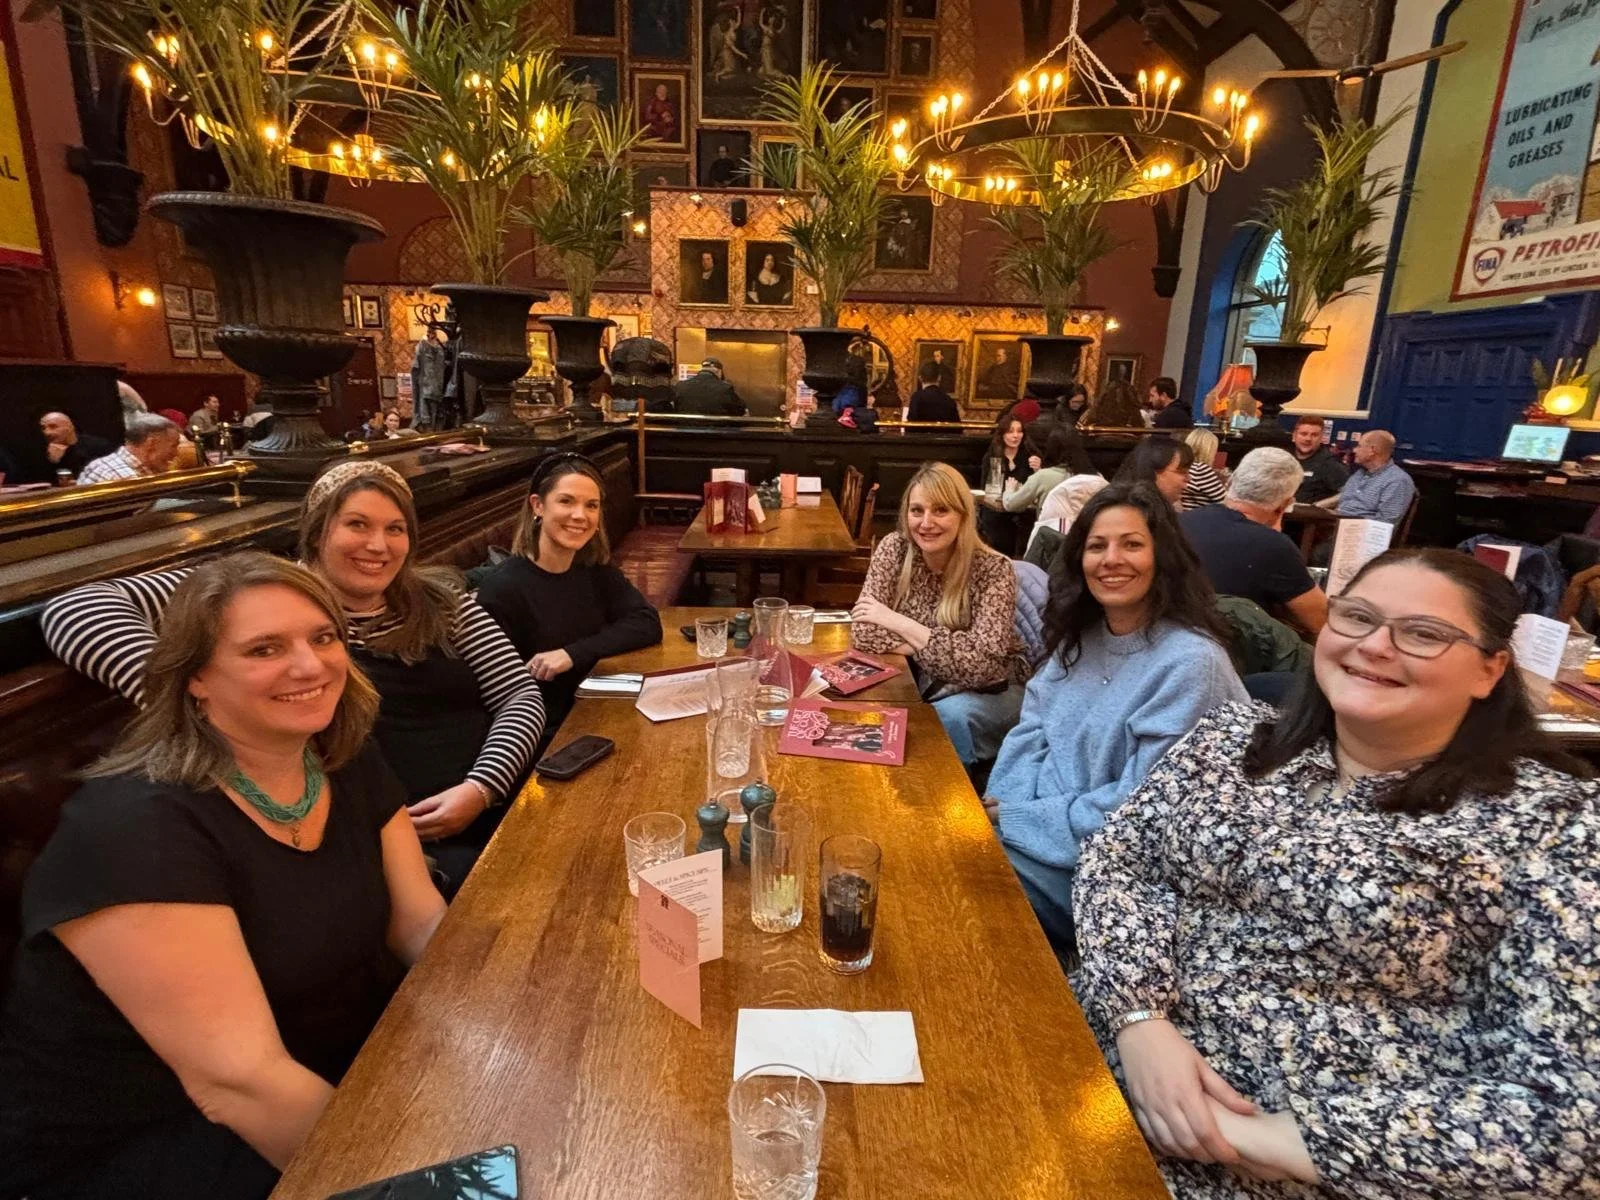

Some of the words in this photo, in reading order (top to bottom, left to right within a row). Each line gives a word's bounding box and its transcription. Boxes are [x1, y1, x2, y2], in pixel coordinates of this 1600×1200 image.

[1505, 82, 1593, 126] LUBRICATING
[1508, 126, 1536, 146] OILS
[1543, 113, 1574, 135] AND
[1508, 140, 1565, 169] GREASES
